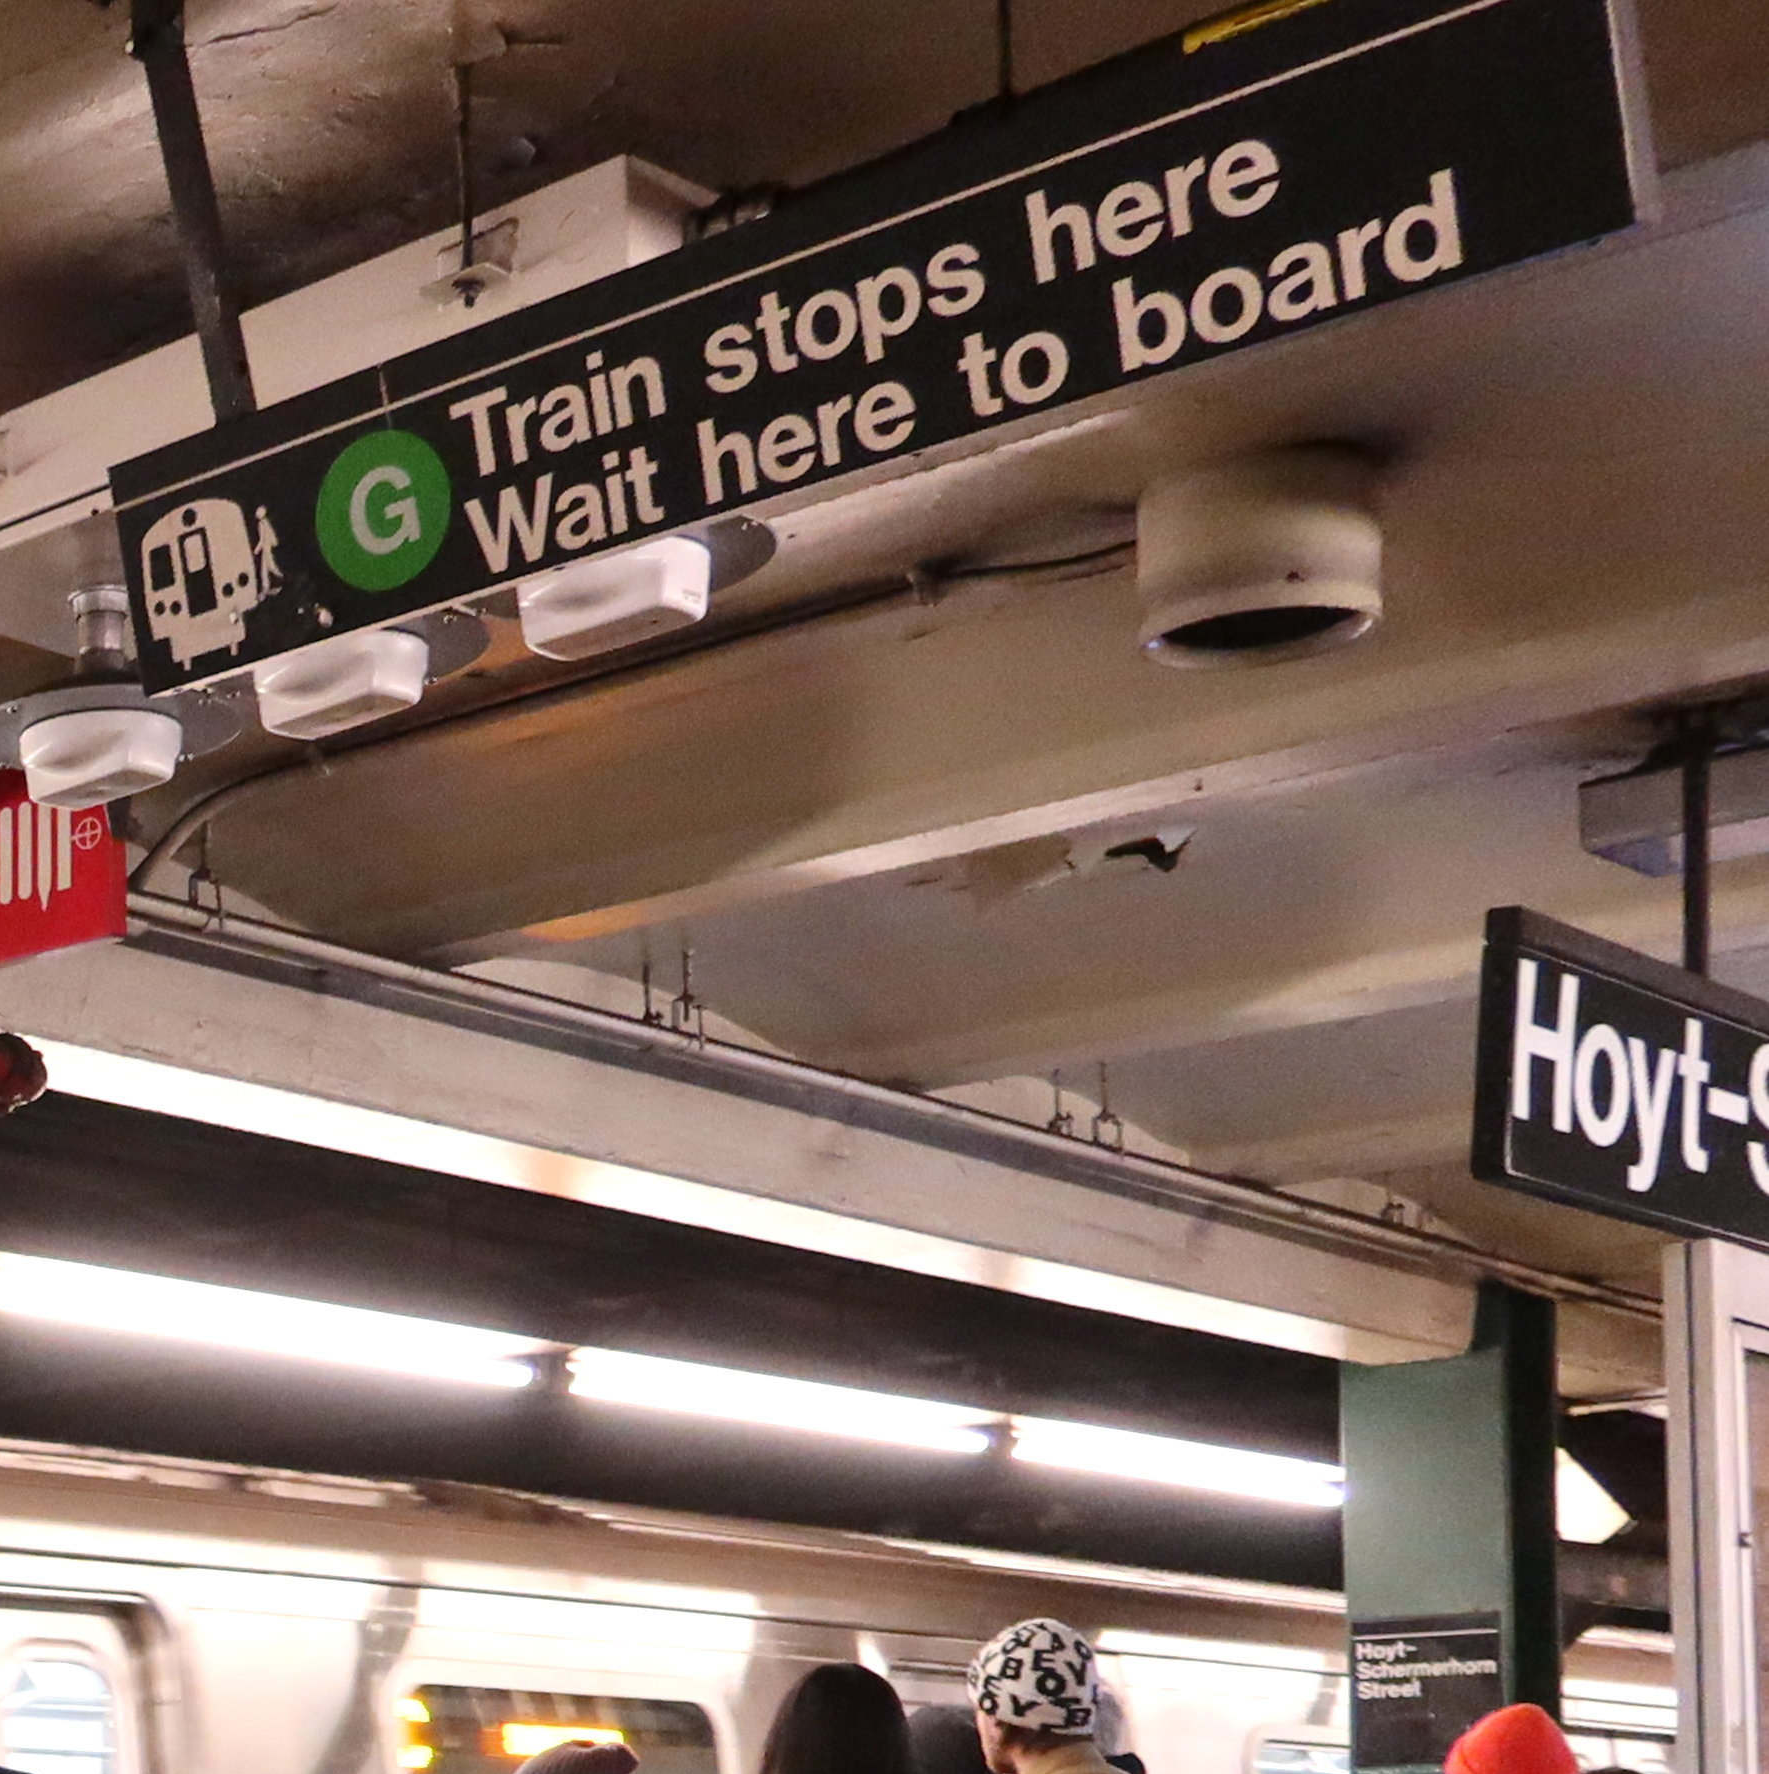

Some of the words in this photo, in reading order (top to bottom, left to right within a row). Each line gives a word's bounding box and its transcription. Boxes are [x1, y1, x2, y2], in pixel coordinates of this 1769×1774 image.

[448, 350, 666, 476] Train
[705, 243, 985, 393] stops
[1026, 140, 1279, 284] here
[464, 446, 664, 573] Wait
[697, 381, 915, 504] here
[958, 331, 1068, 416] to
[1112, 168, 1462, 372] board
[348, 465, 421, 555] G
[1355, 1640, 1417, 1662] Hoyt-
[1356, 1678, 1422, 1700] Street
